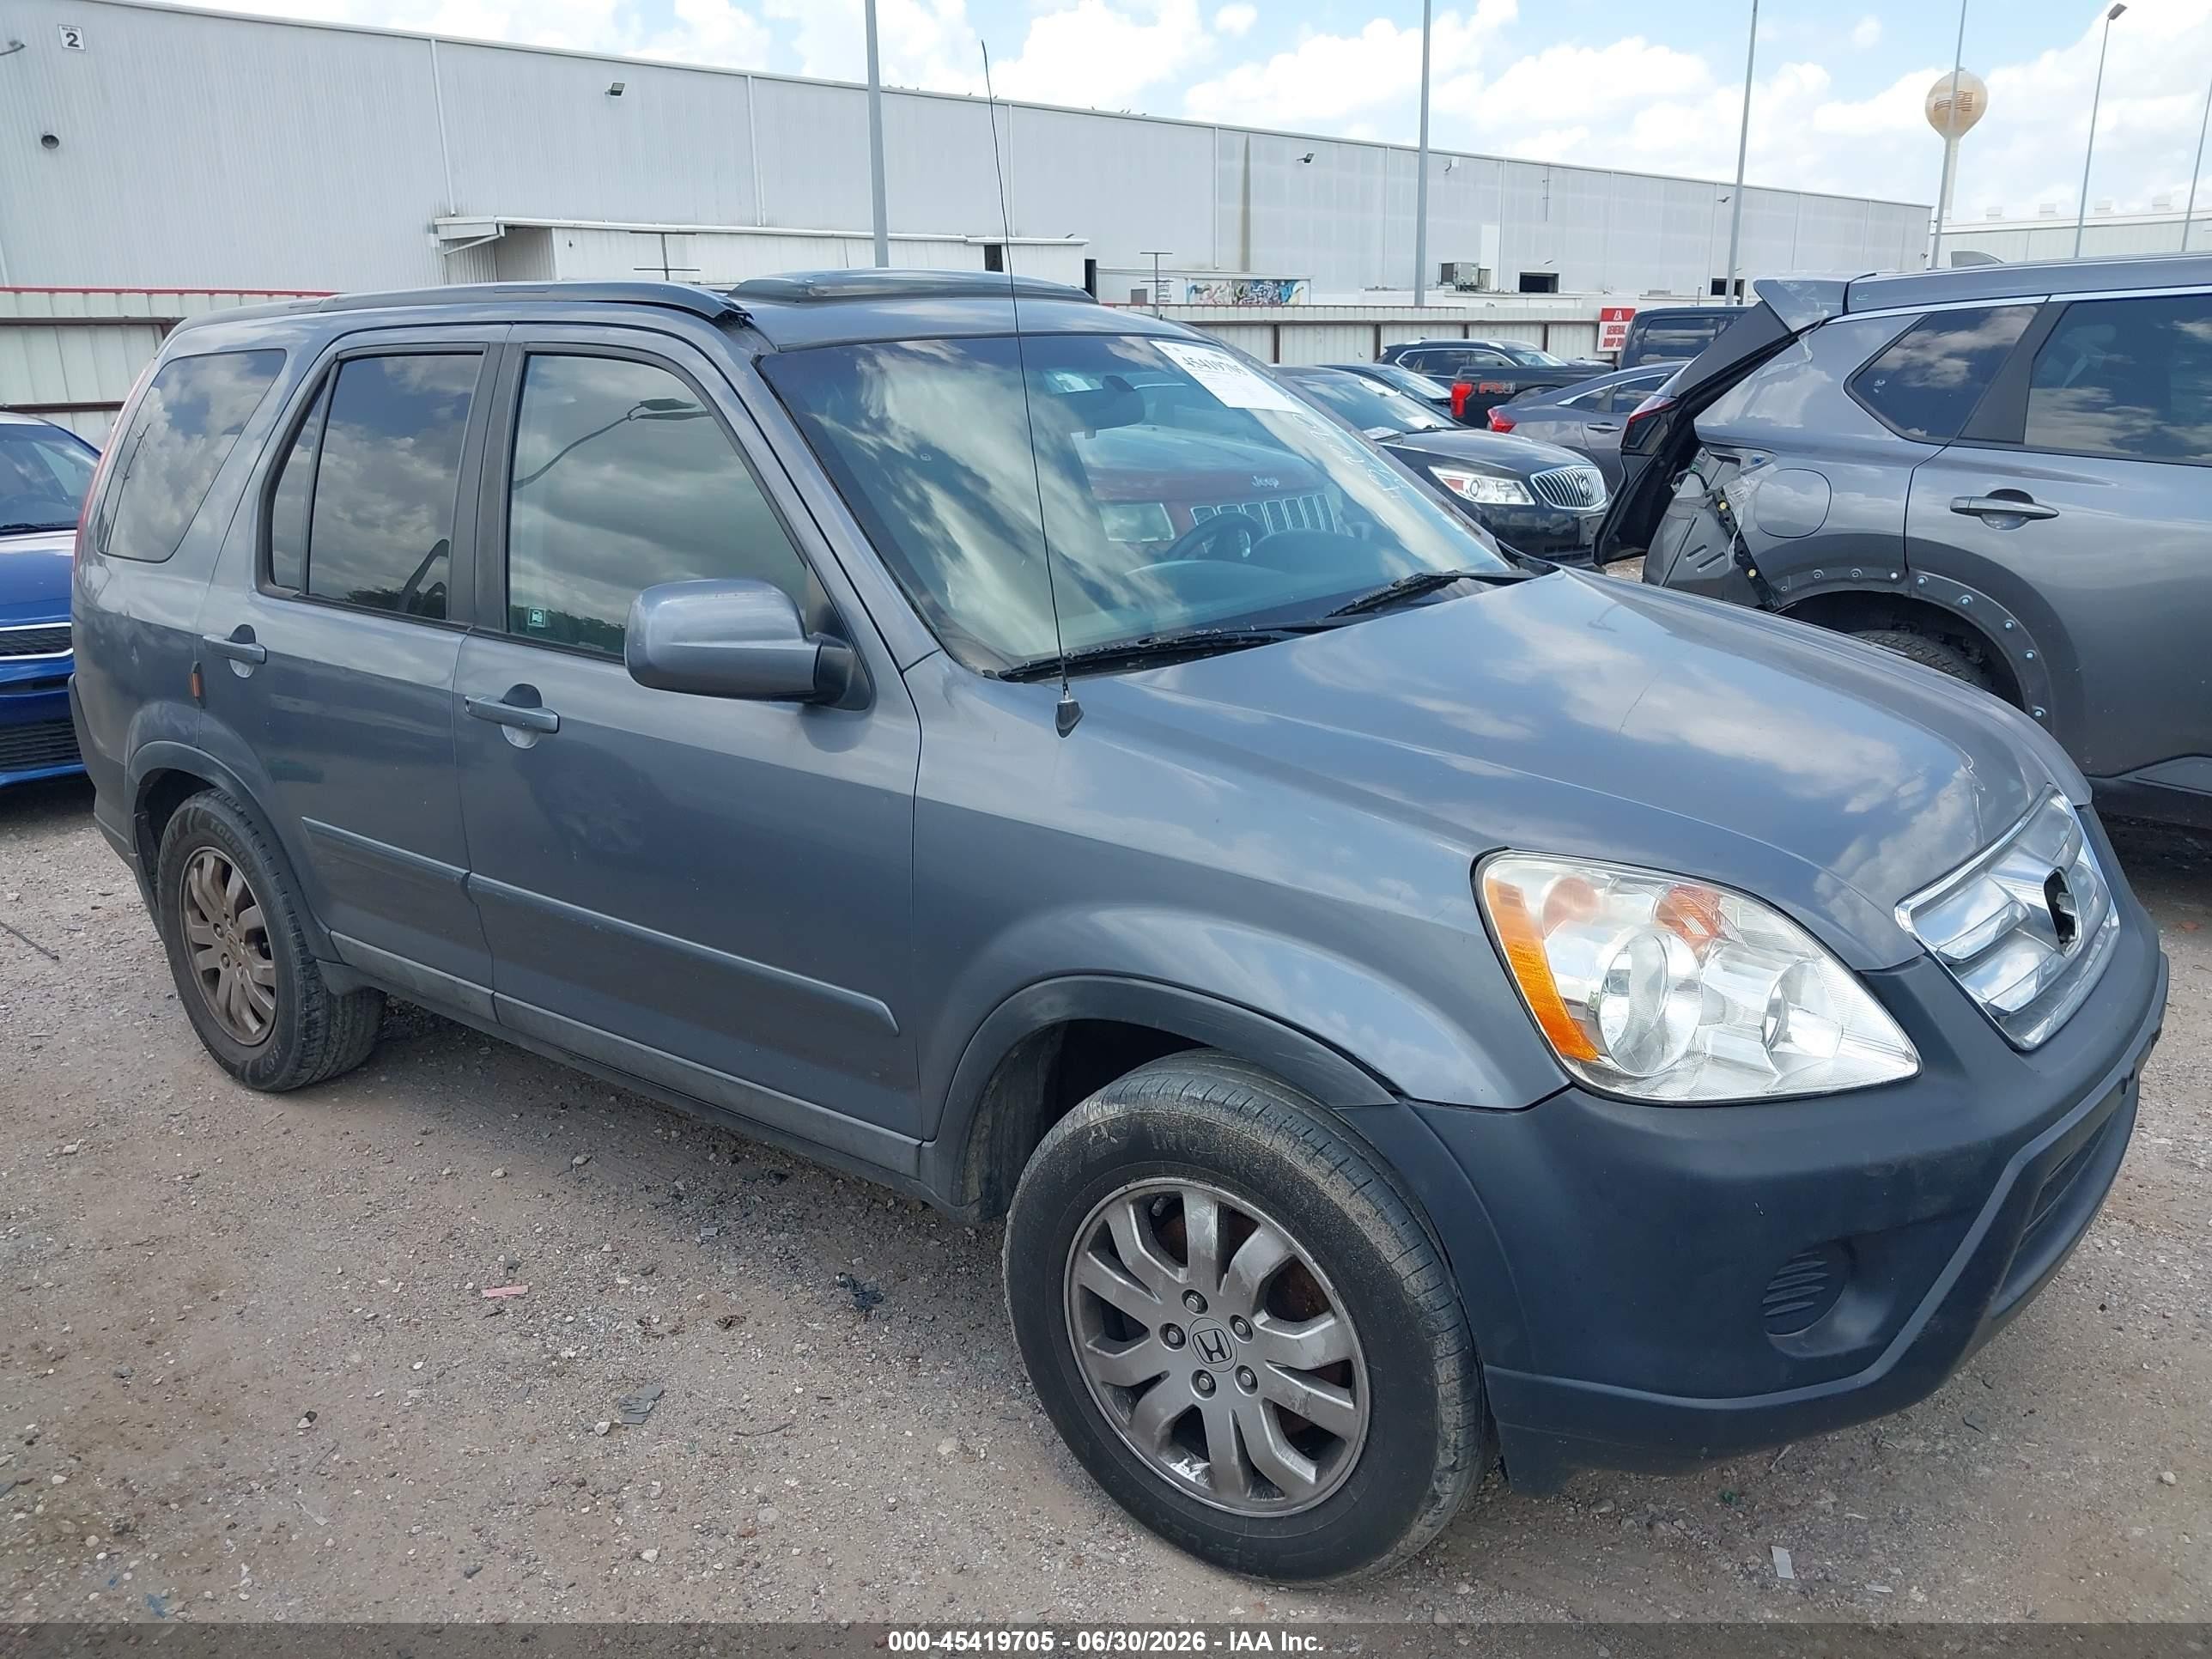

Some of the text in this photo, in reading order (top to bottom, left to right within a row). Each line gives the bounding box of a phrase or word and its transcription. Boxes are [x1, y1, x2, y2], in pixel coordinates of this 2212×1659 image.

[66, 32, 80, 48] 2
[1479, 382, 1516, 395] FX4
[1251, 475, 1279, 489] Jeep
